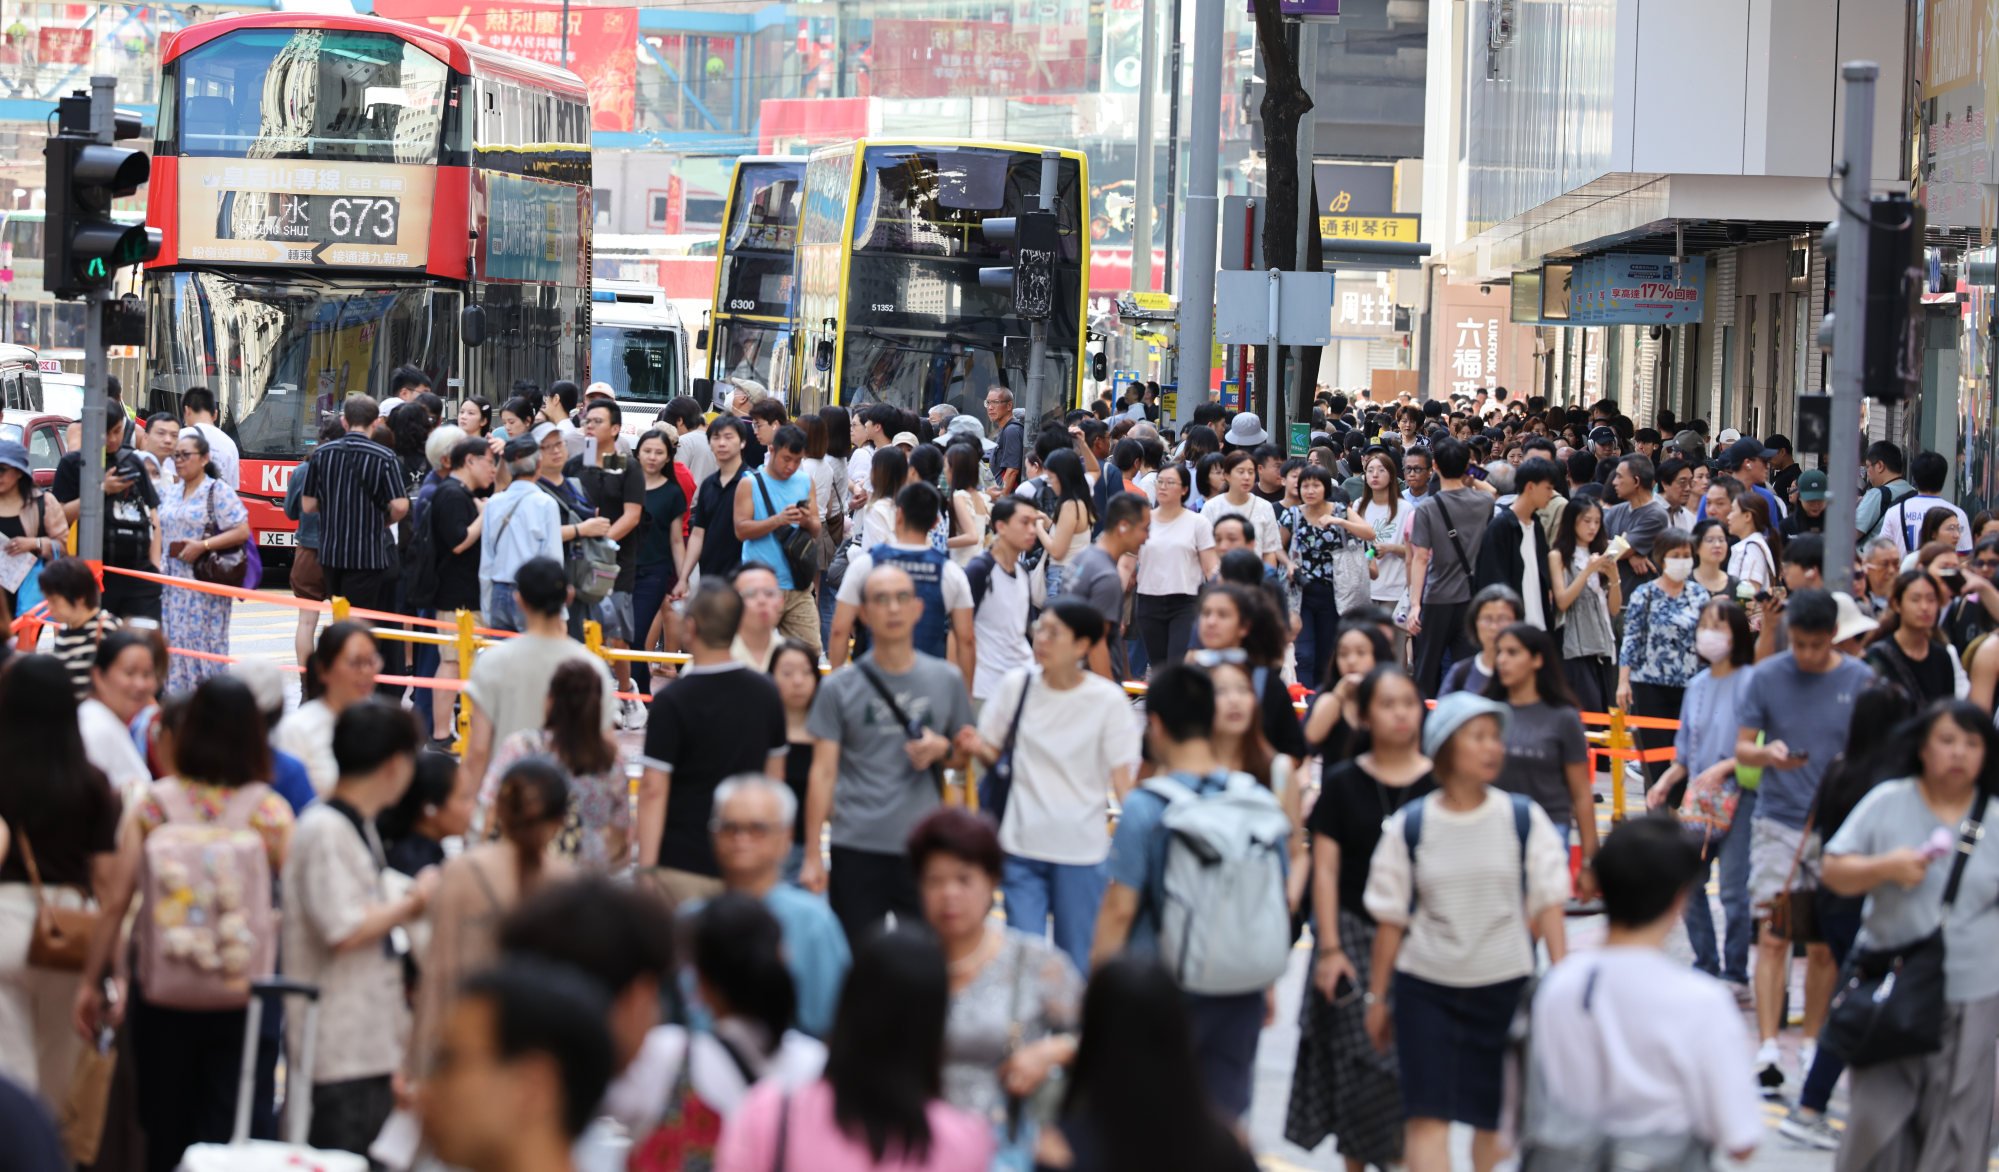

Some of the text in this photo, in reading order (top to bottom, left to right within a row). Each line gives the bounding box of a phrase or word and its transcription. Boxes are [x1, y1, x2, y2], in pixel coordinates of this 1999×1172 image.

[329, 198, 394, 238] 673
[283, 225, 309, 236] SHUI
[1321, 219, 1399, 237] 通利琴行
[730, 299, 755, 310] 6300
[871, 303, 894, 312] 51352
[38, 361, 57, 371] XI
[1905, 511, 1928, 521] MBA
[267, 533, 285, 546] XE
